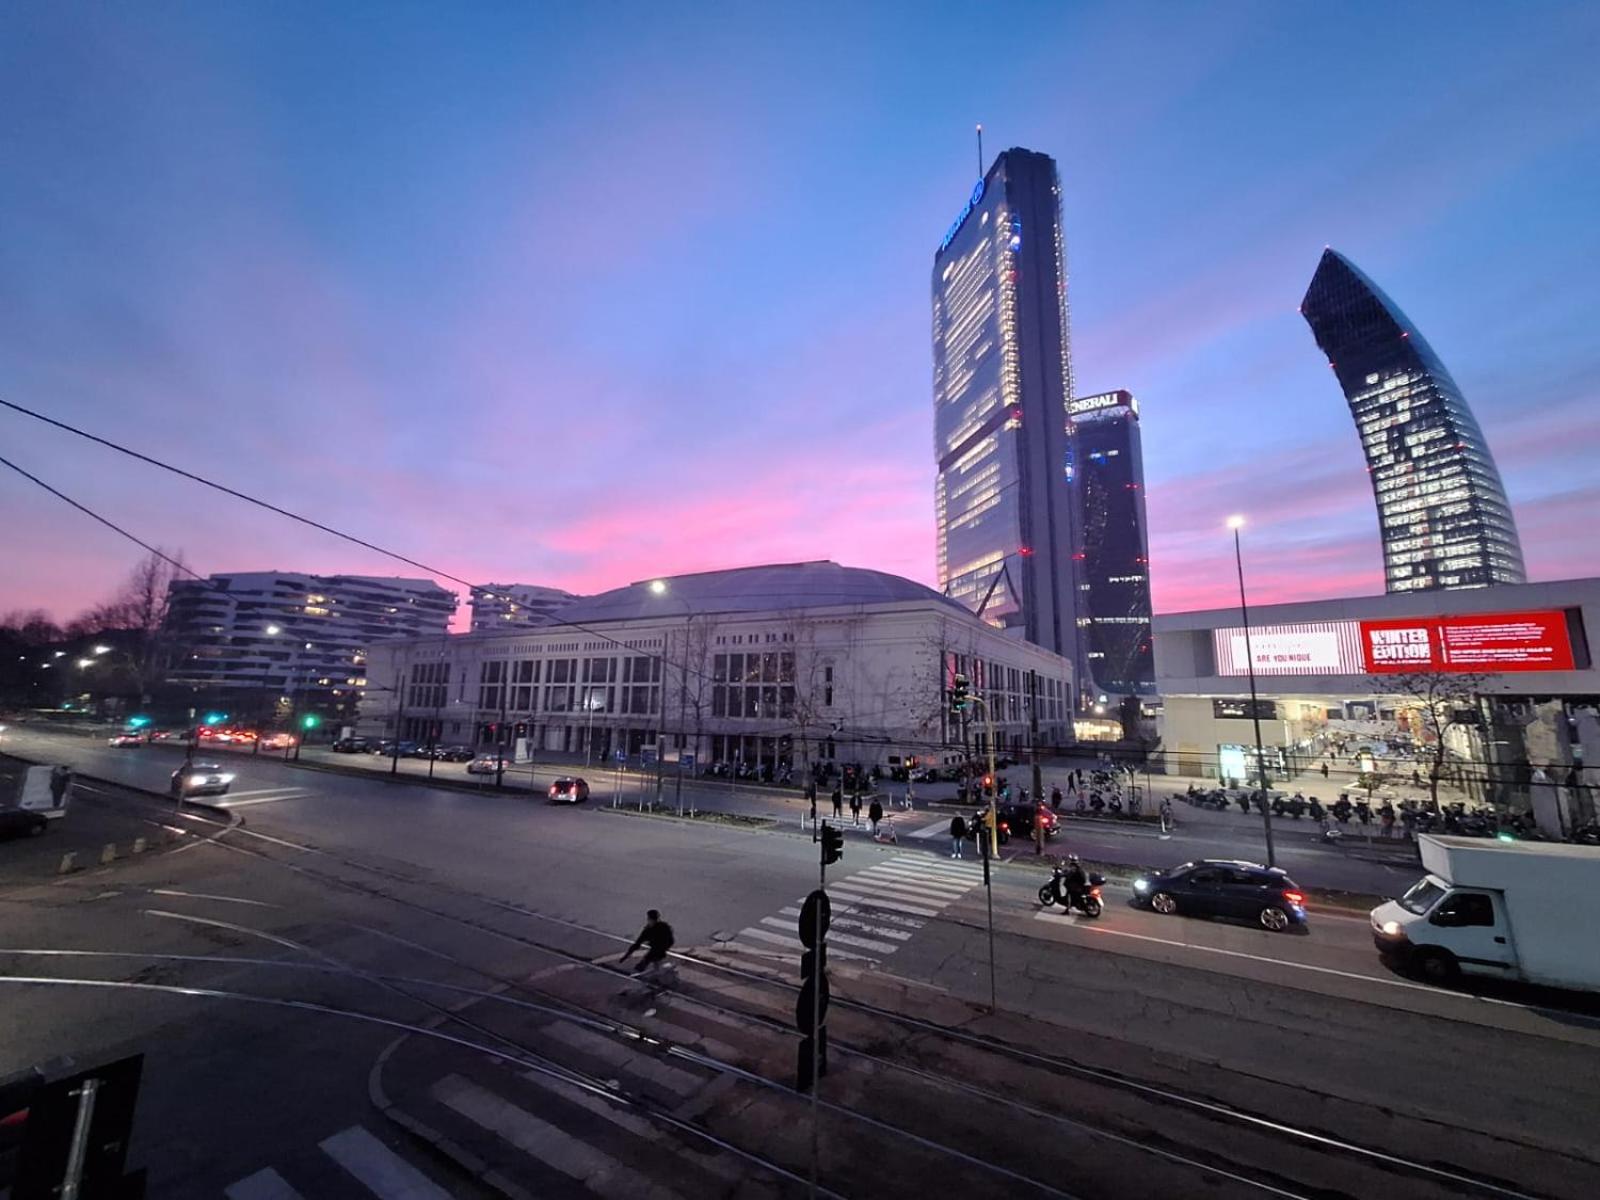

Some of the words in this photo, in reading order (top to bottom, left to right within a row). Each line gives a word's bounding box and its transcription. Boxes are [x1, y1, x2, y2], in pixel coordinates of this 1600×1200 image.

[1369, 628, 1429, 645] WINTER
[1256, 654, 1270, 662] ARE
[1371, 643, 1431, 660] EDITION
